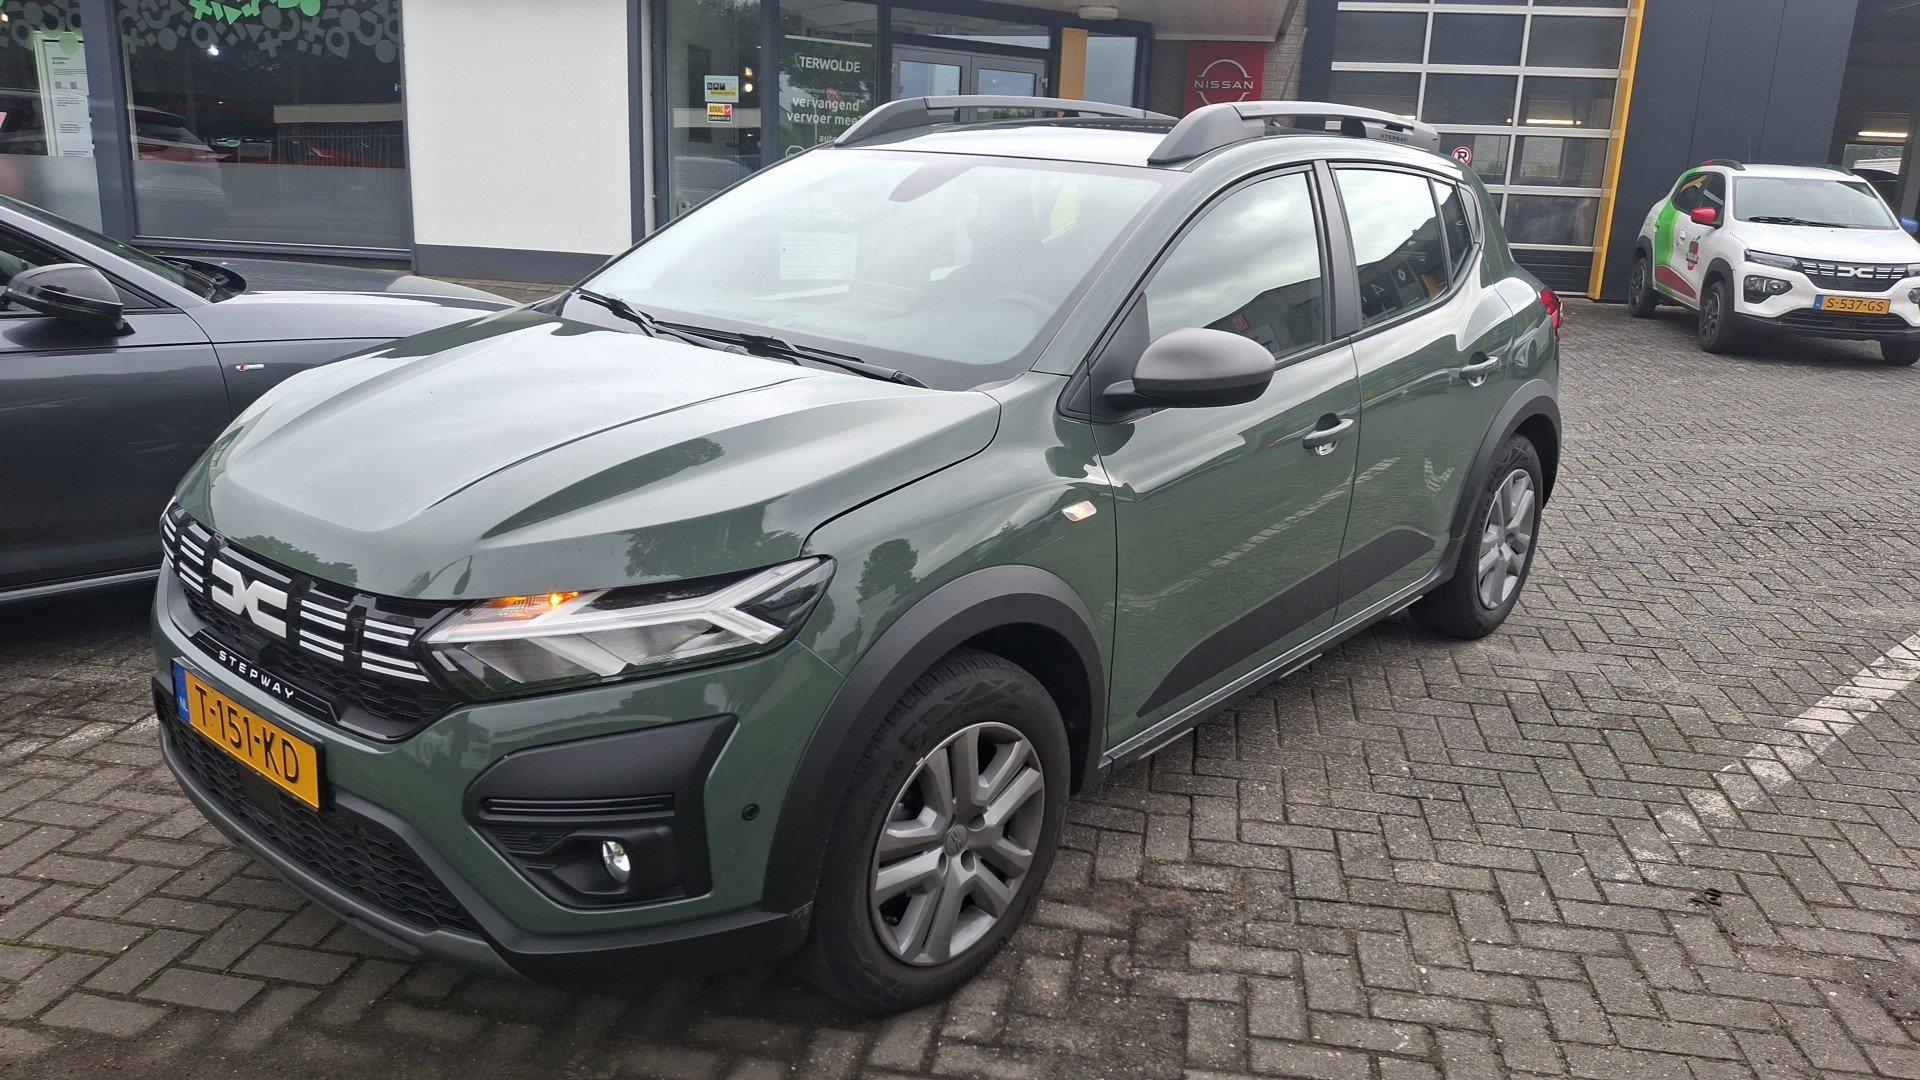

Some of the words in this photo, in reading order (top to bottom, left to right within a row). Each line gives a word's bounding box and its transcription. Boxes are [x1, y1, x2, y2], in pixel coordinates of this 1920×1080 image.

[799, 55, 861, 73] TERWOLDE
[1194, 80, 1254, 89] NISSAN
[709, 105, 724, 113] BOVAG
[792, 97, 860, 112] vervangend
[787, 112, 833, 124] vervoer
[1827, 298, 1884, 311] S-537-GS
[218, 650, 294, 699] STEPWAY
[195, 683, 299, 784] T-151-KD
